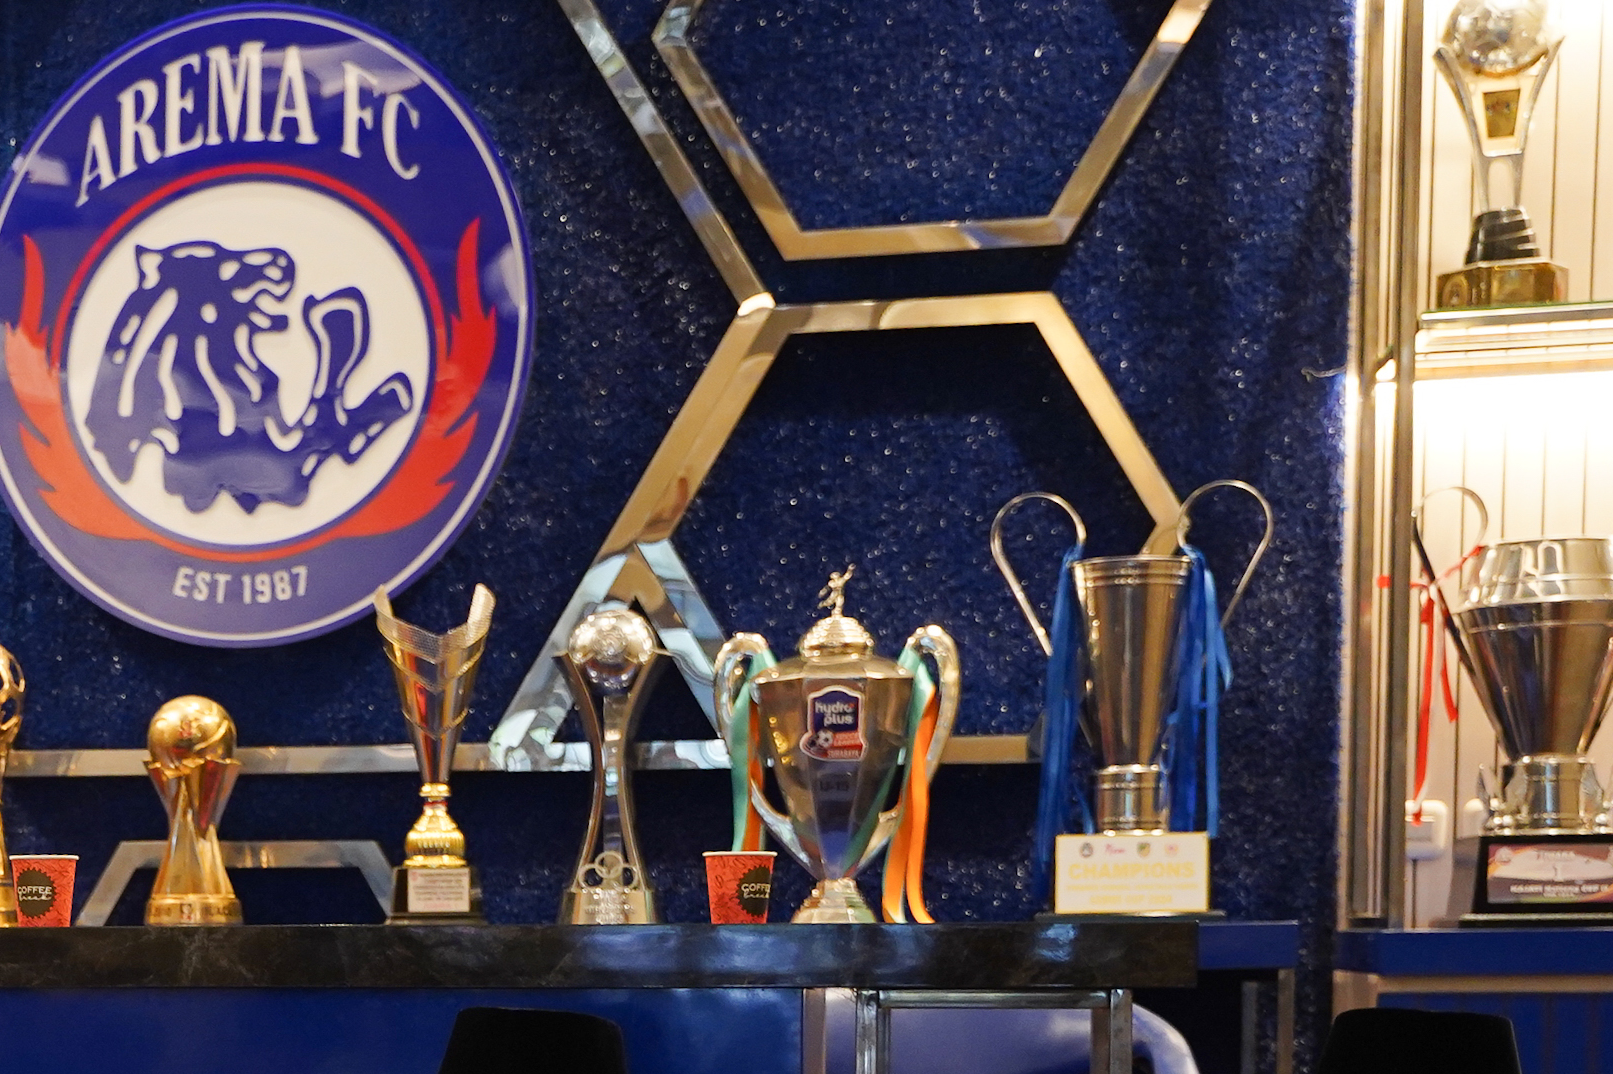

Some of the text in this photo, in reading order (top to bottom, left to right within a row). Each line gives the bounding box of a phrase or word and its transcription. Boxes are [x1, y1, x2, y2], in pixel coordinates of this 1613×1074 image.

[76, 41, 421, 207] AREMA FC
[172, 565, 308, 604] EST 1987
[824, 713, 854, 726] plus
[1068, 861, 1194, 879] CHAMPIONS
[17, 886, 53, 894] COFFEE
